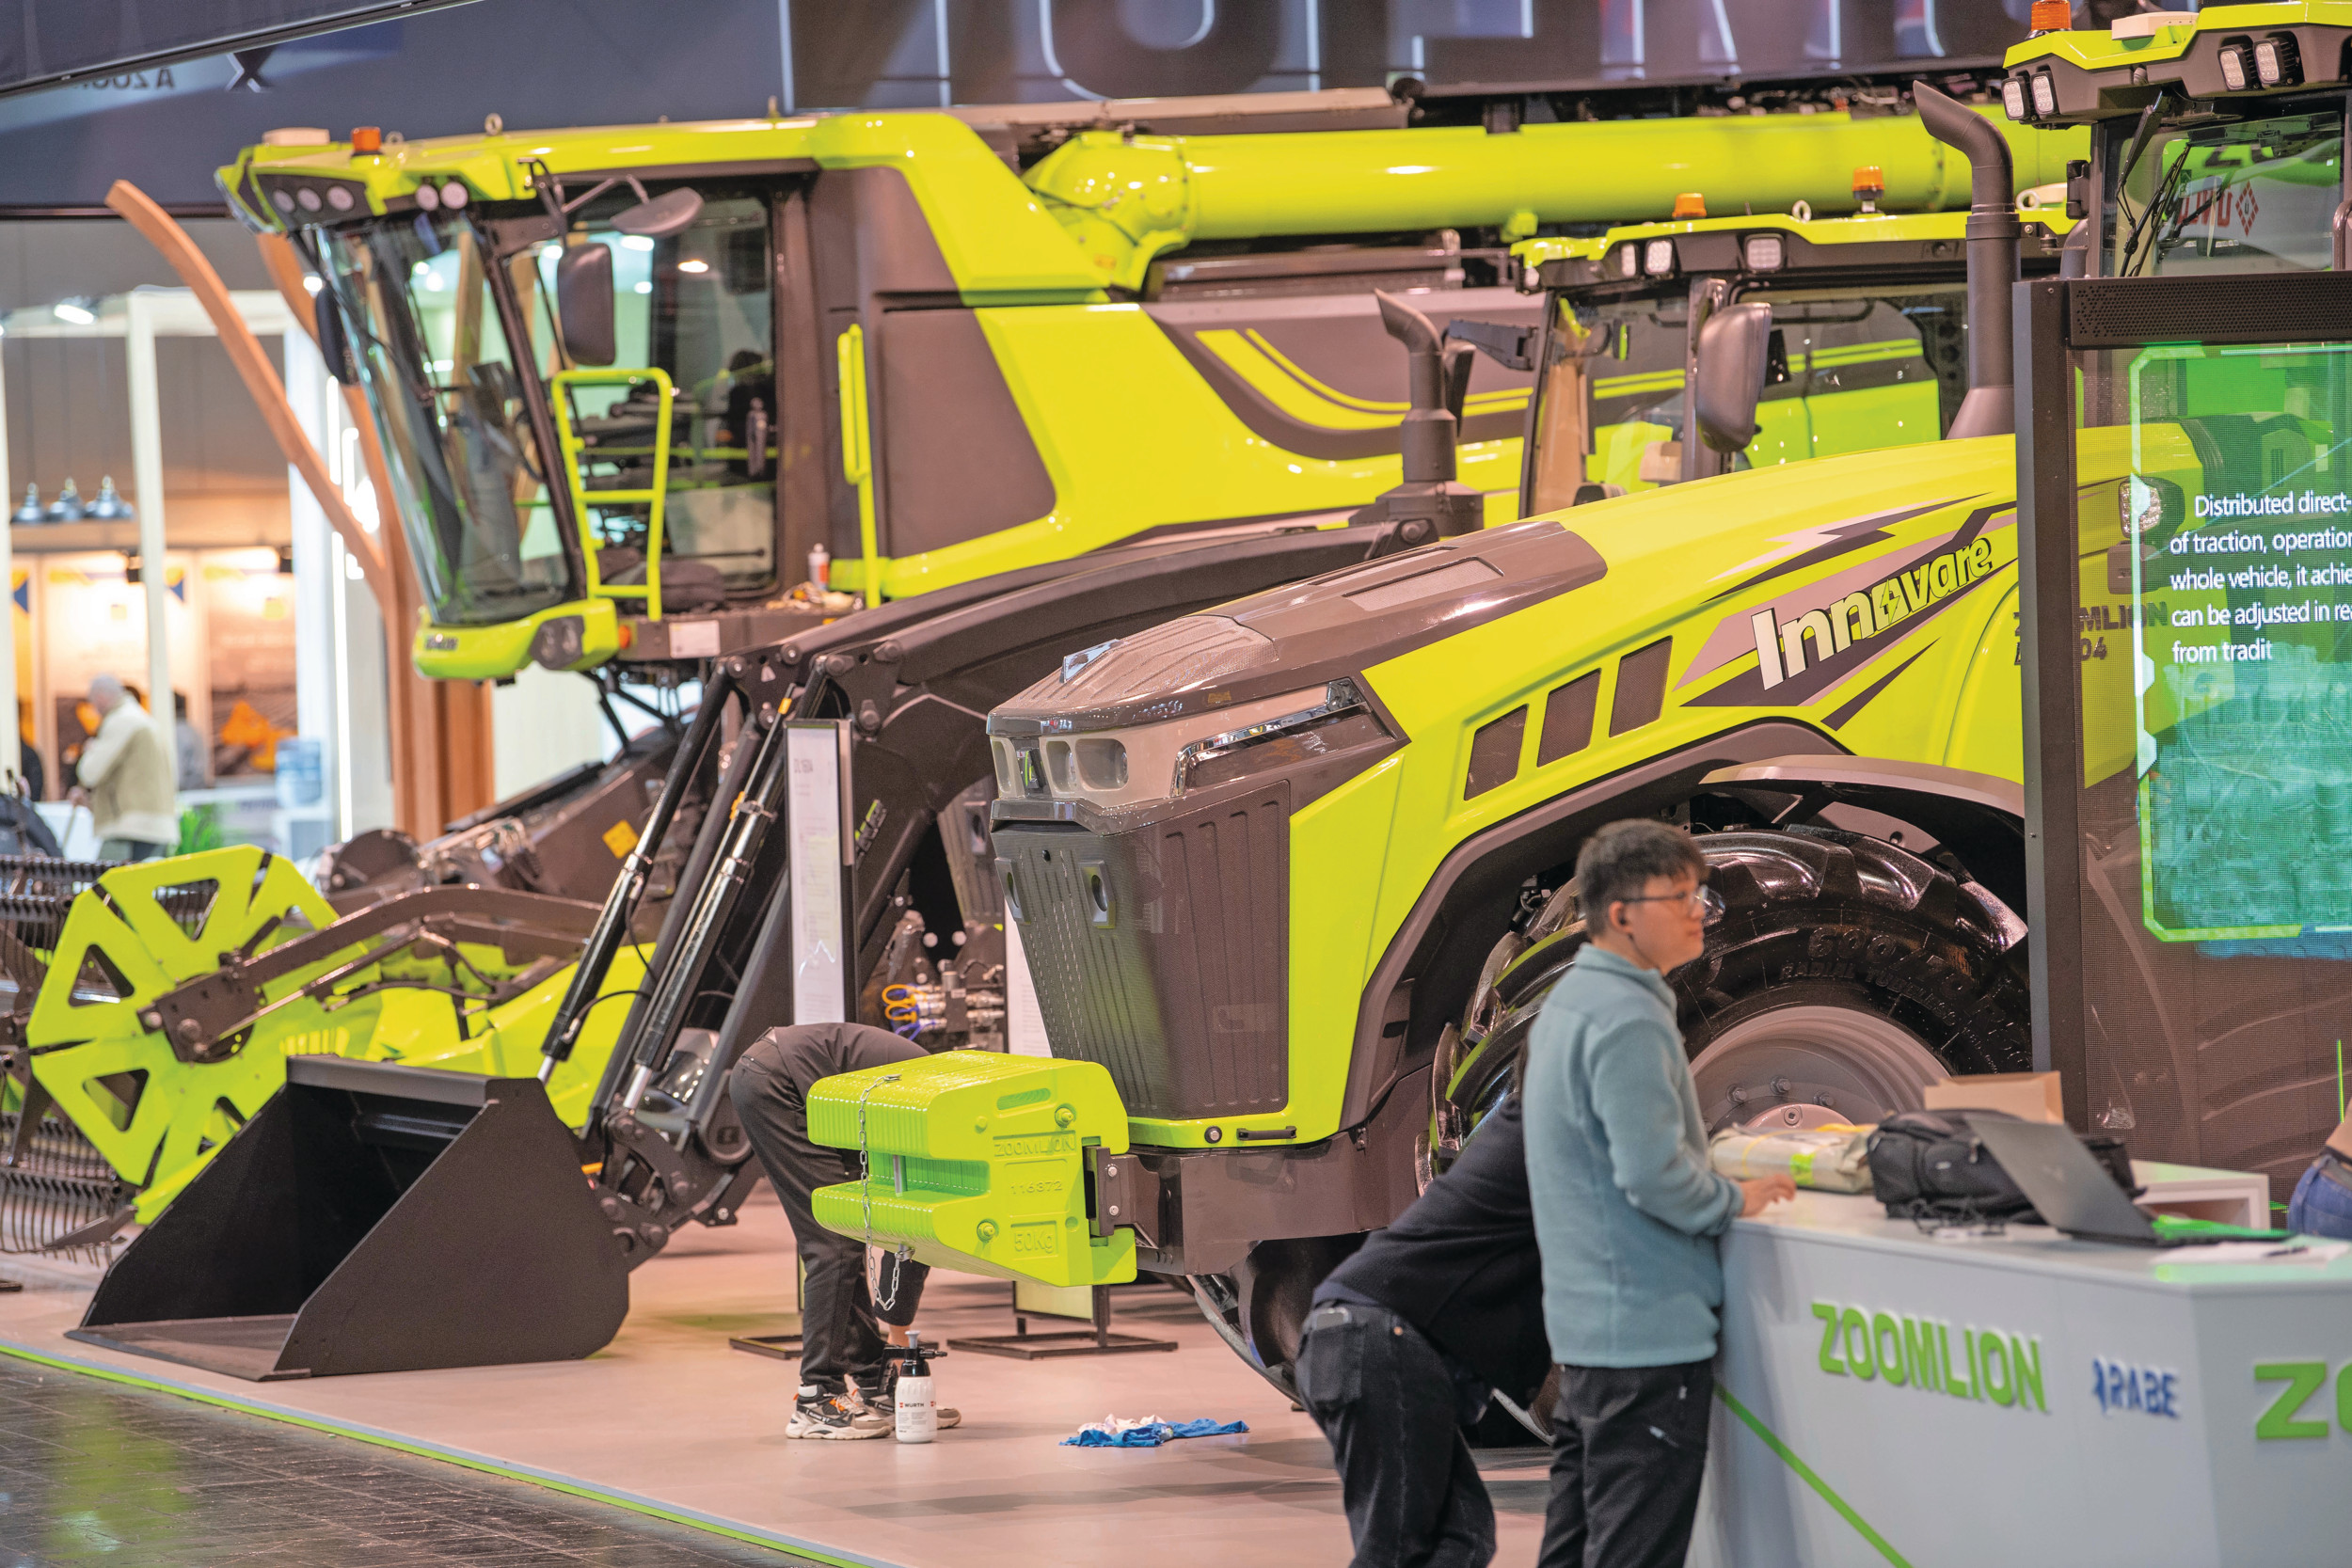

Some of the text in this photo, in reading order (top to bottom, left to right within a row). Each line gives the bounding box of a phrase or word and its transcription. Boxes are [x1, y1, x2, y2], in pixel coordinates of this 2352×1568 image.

[2194, 490, 2352, 517] Distributed direct-
[2169, 531, 2189, 554] of
[2193, 530, 2267, 554] traction,
[2169, 566, 2225, 591] whole
[2228, 564, 2292, 590] vehicle,
[2296, 563, 2308, 586] it
[1751, 538, 1993, 691] Innovare
[2171, 610, 2203, 627] can
[2207, 603, 2231, 626] be
[2234, 600, 2311, 630] adjusted
[2313, 600, 2330, 622] in
[2172, 638, 2274, 664] from tradit
[993, 1134, 1076, 1157] ZOOMLION
[1010, 1180, 1063, 1195] 116372
[1811, 1298, 2049, 1413] ZOOMLION
[2255, 1360, 2352, 1440] Z
